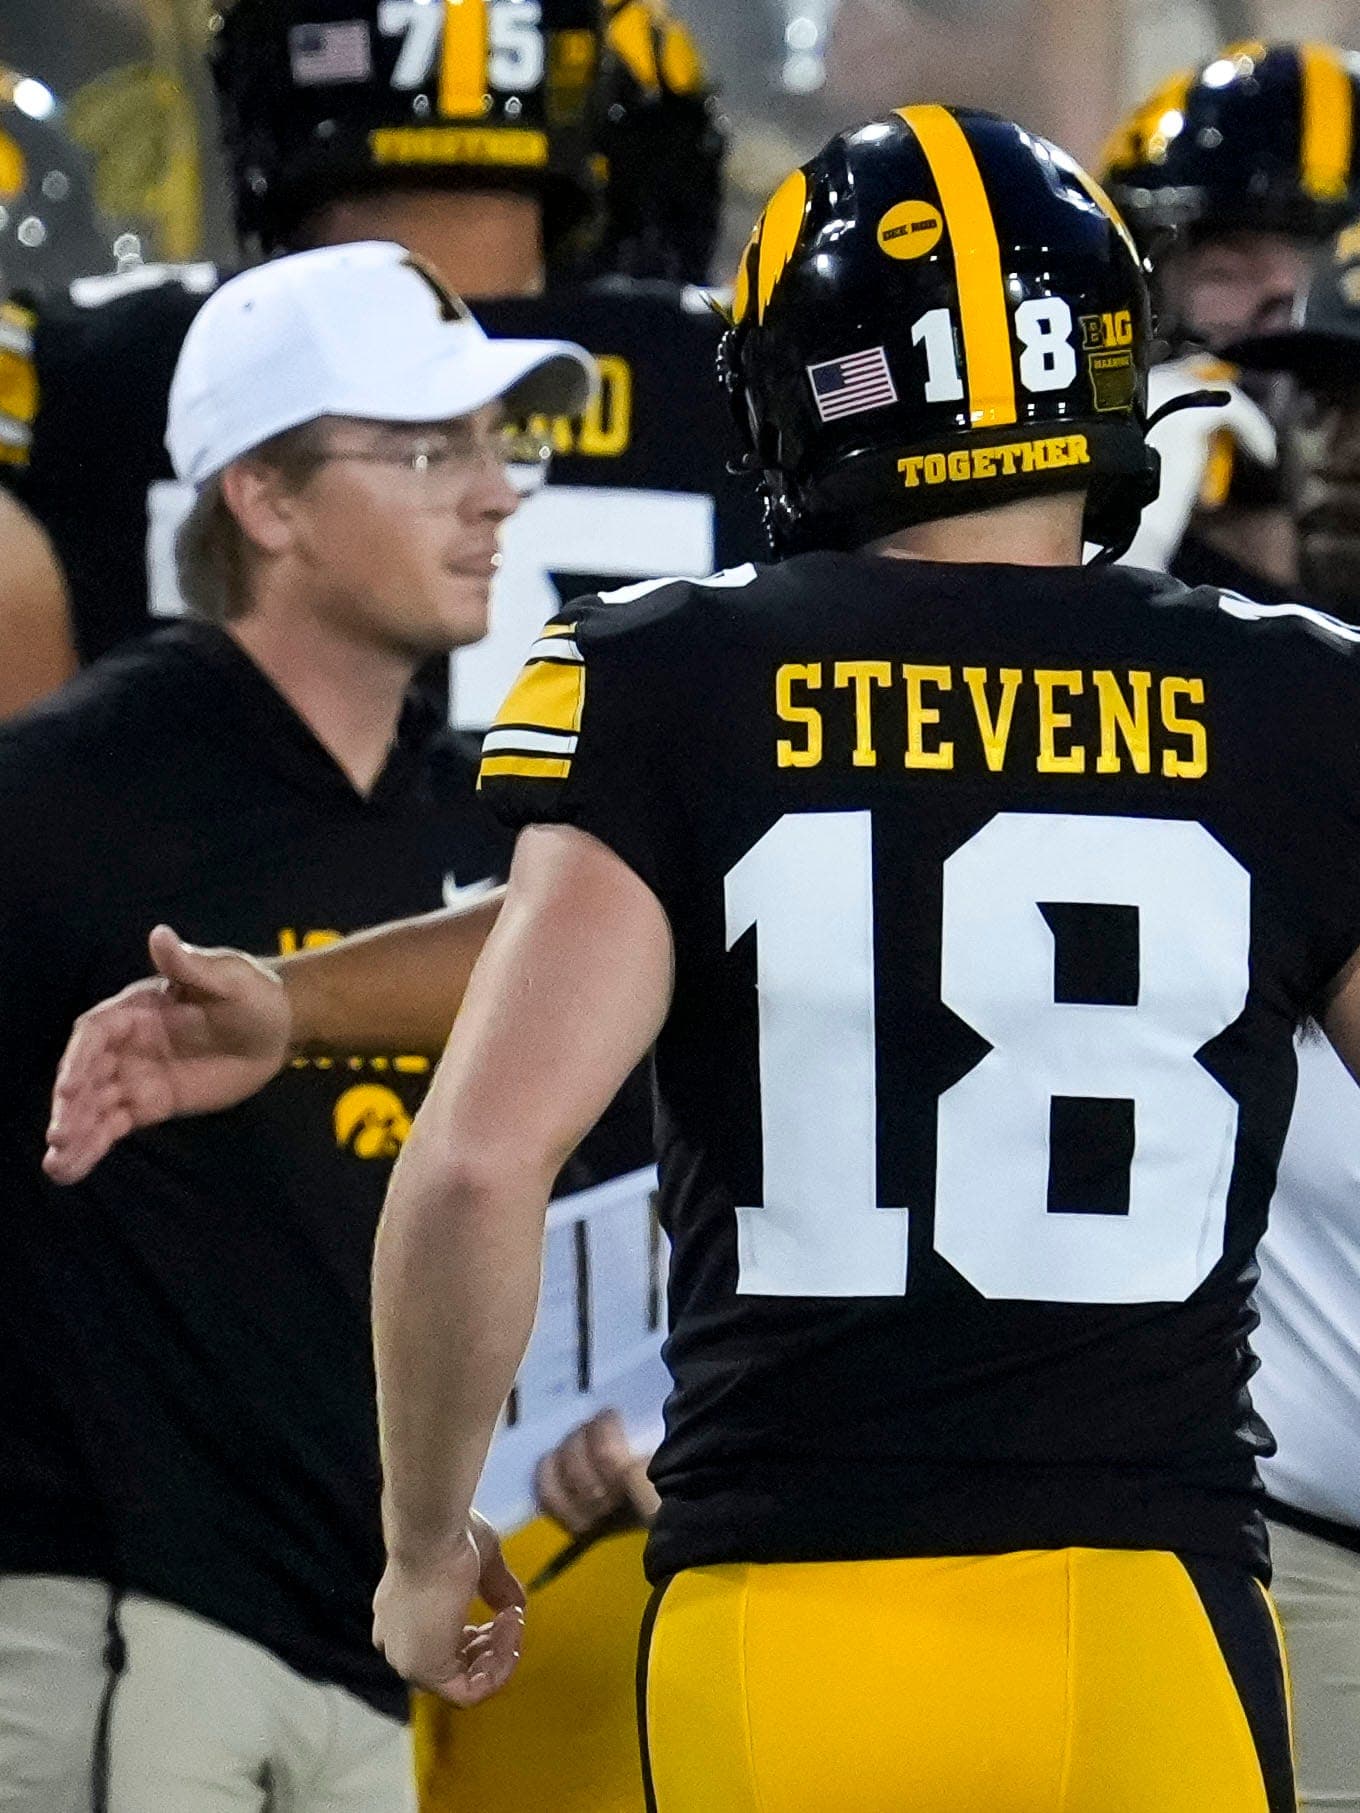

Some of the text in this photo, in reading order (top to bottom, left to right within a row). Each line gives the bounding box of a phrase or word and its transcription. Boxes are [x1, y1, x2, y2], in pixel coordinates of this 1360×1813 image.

[376, 0, 543, 90] 75
[911, 297, 1076, 402] 18
[897, 434, 1090, 488] TOGETHER
[775, 661, 1207, 778] STEVENS
[724, 809, 1251, 1302] 18
